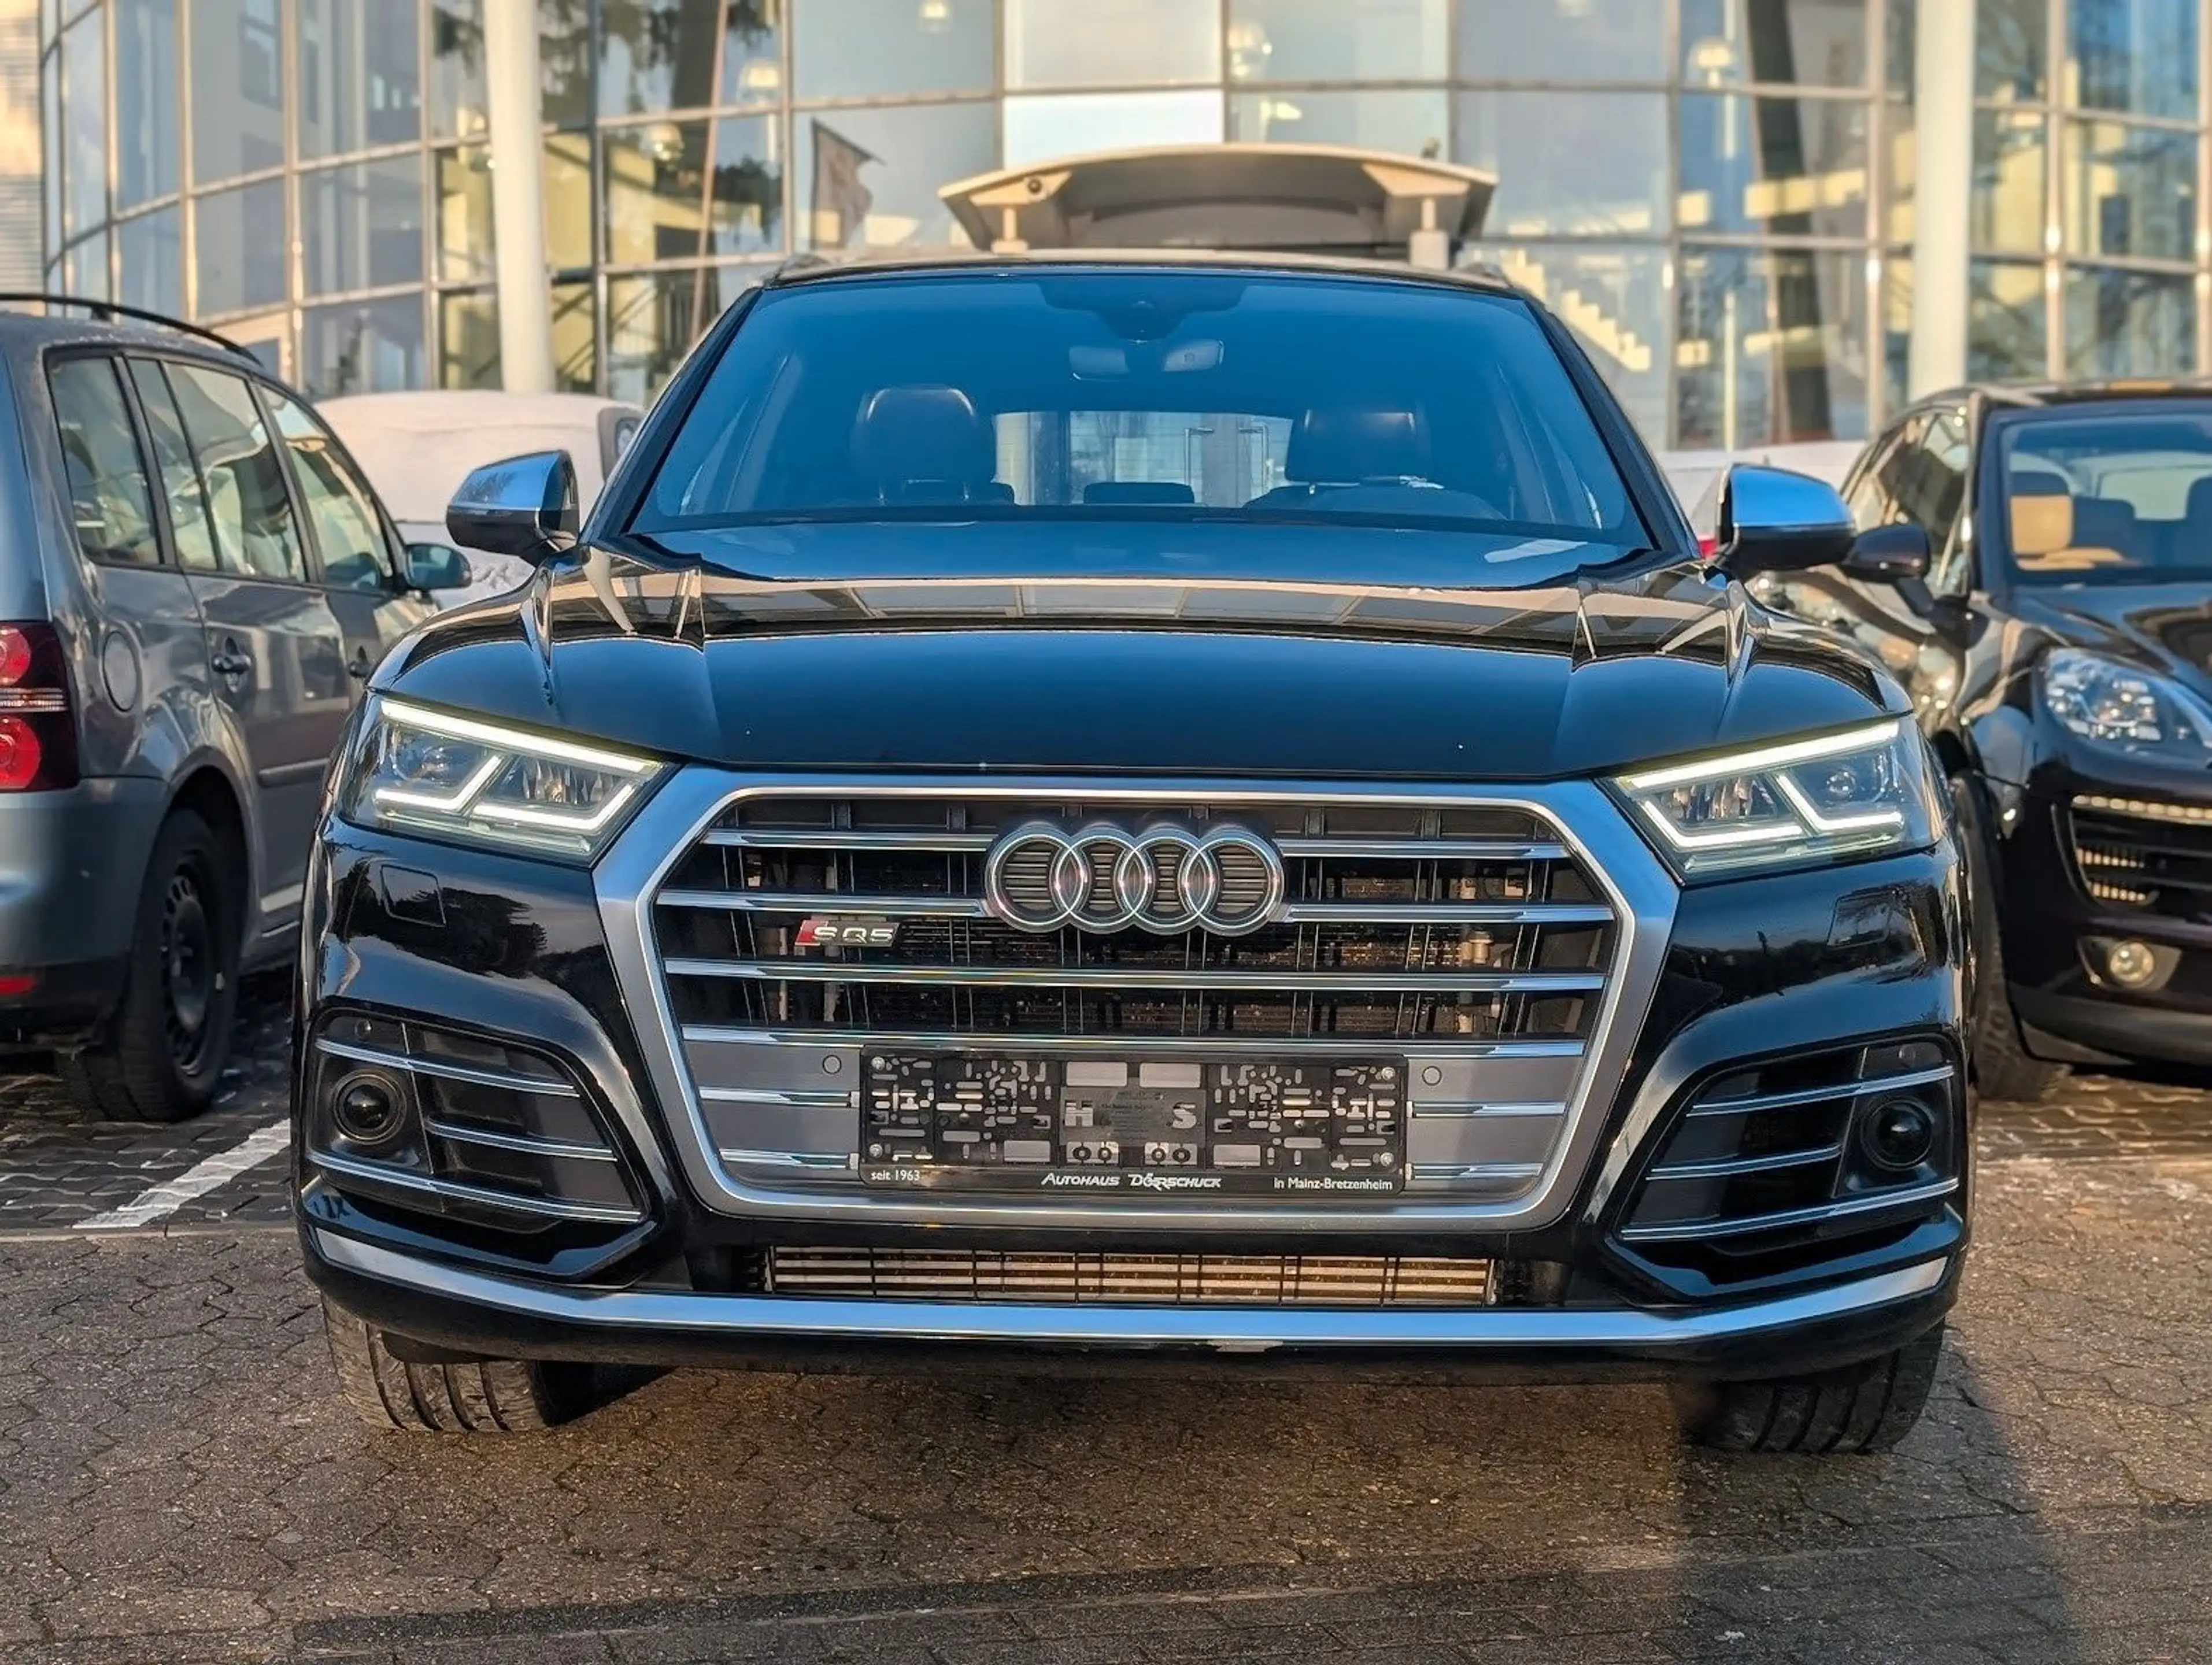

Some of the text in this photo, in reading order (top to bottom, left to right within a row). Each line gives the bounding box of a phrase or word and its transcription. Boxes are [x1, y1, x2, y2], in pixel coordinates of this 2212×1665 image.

[812, 926, 894, 944] SQ5
[871, 1170, 920, 1181] seit 1963
[1041, 1172, 1120, 1186] AUTOHAUS
[1274, 1177, 1393, 1190] in Mainz-Bretzenheim
